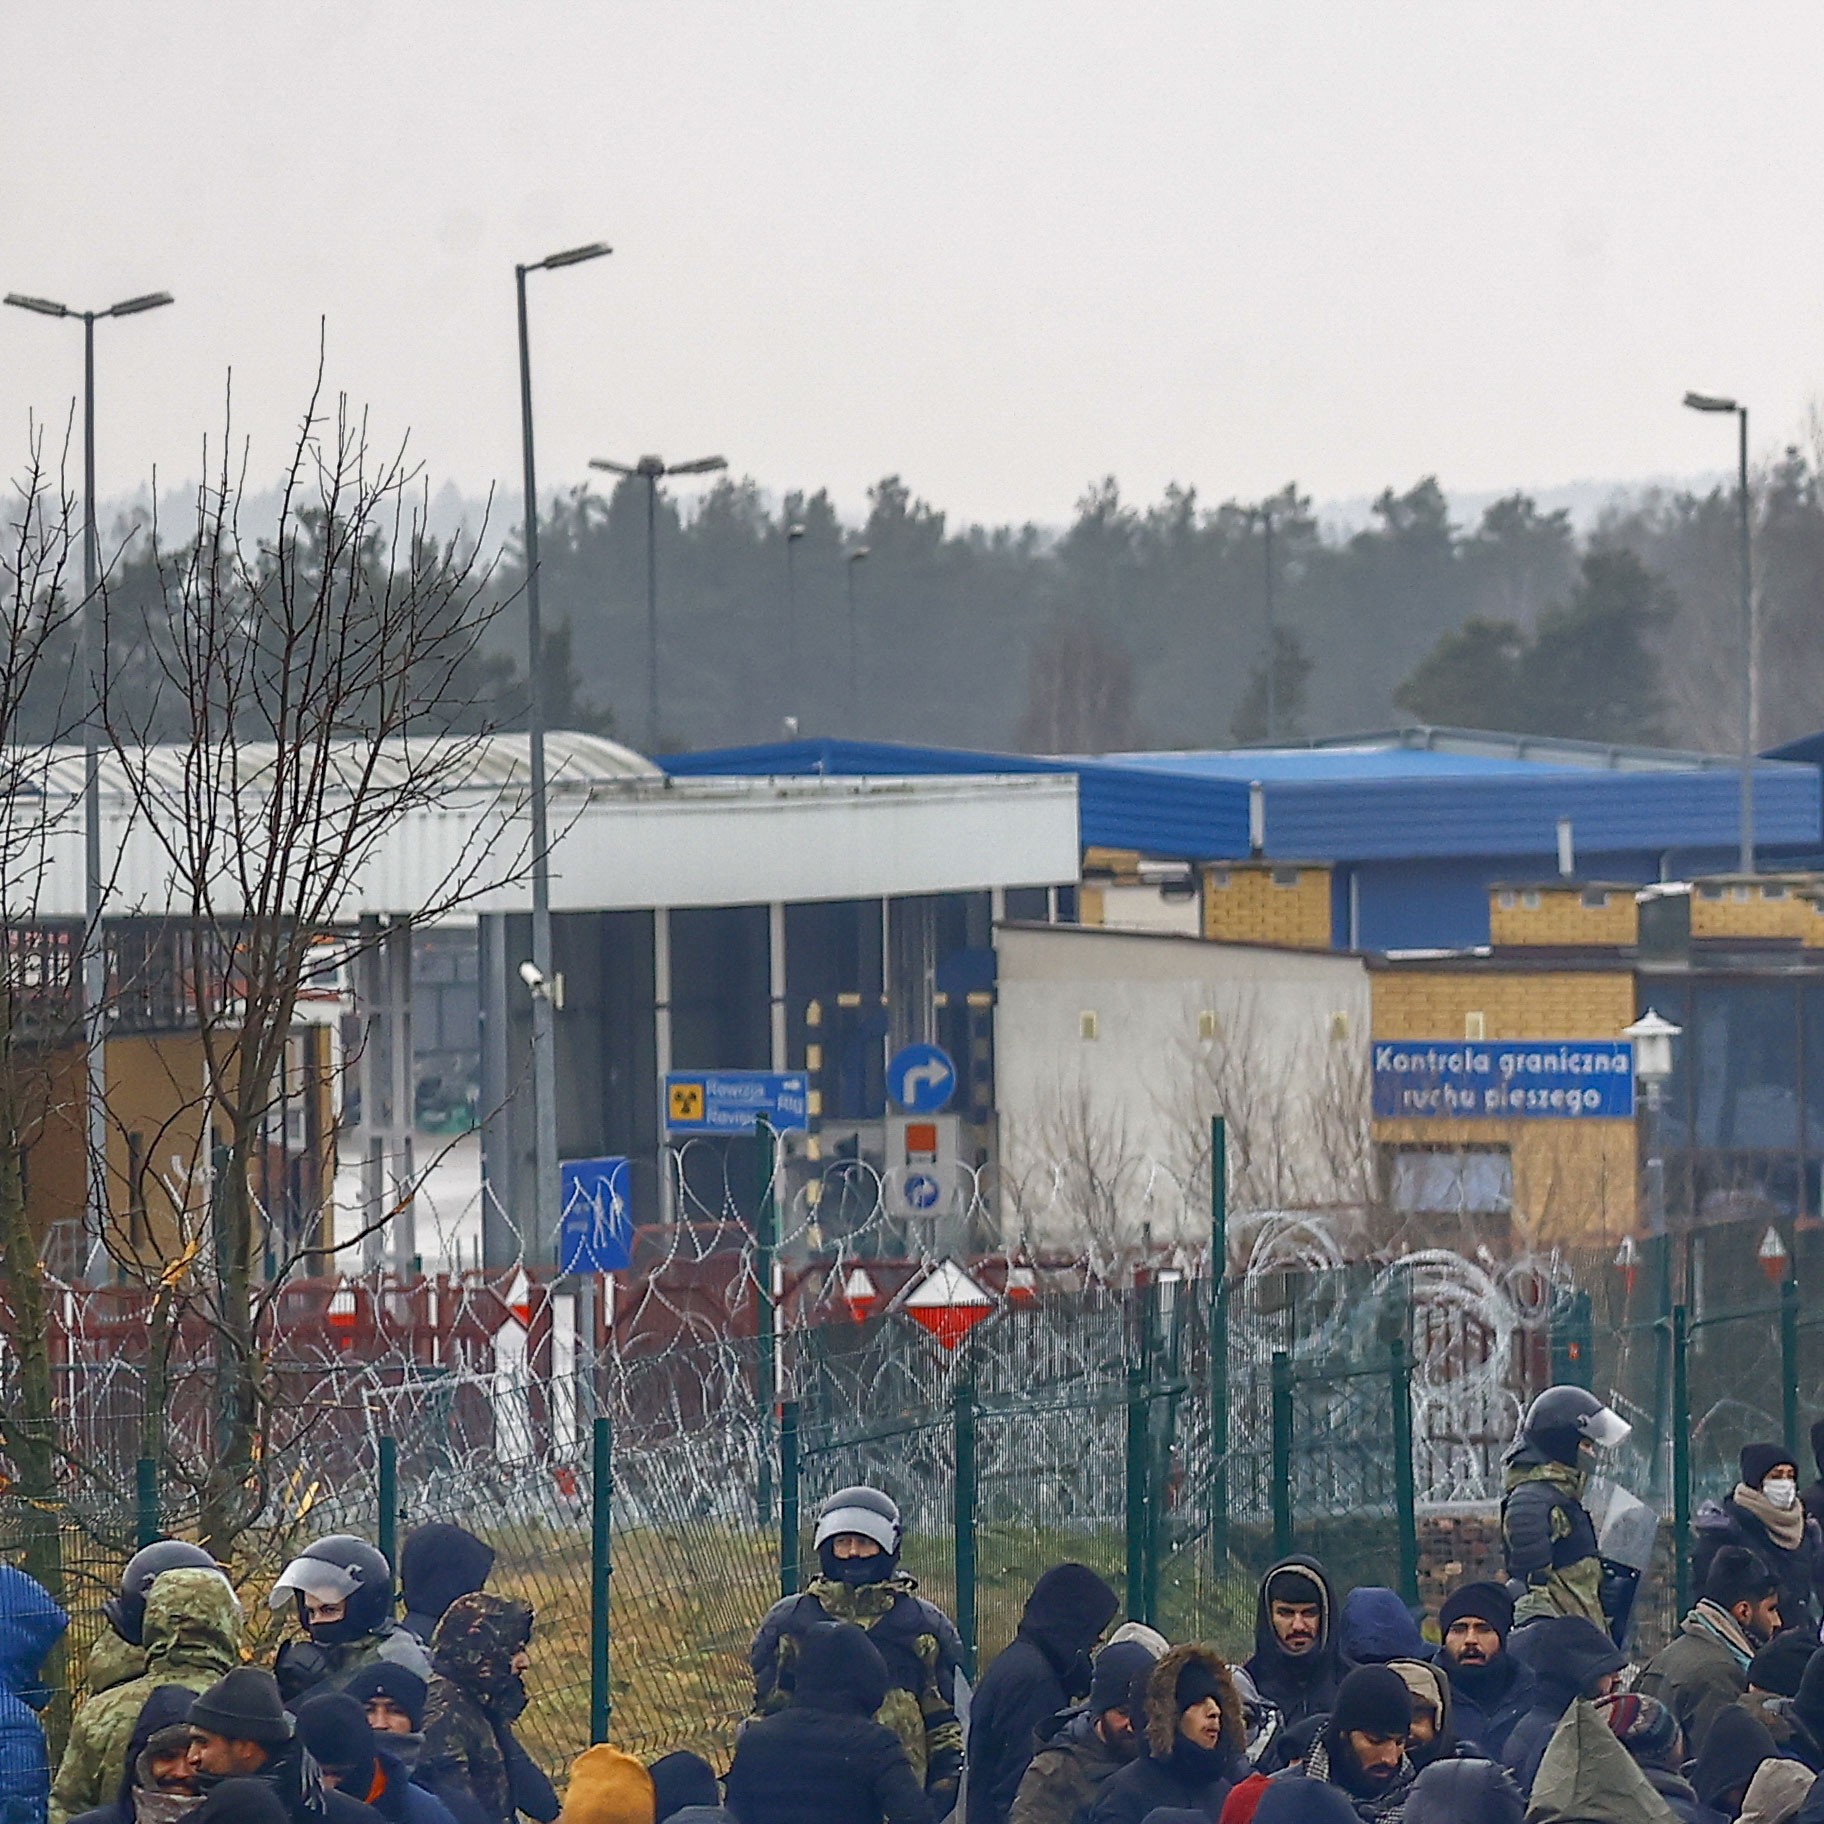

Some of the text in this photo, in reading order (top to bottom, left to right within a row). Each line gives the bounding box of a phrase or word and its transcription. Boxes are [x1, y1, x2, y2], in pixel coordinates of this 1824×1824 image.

[1376, 1046, 1629, 1080] Kontrola graniczna
[1403, 1083, 1601, 1115] ruchu pieszego
